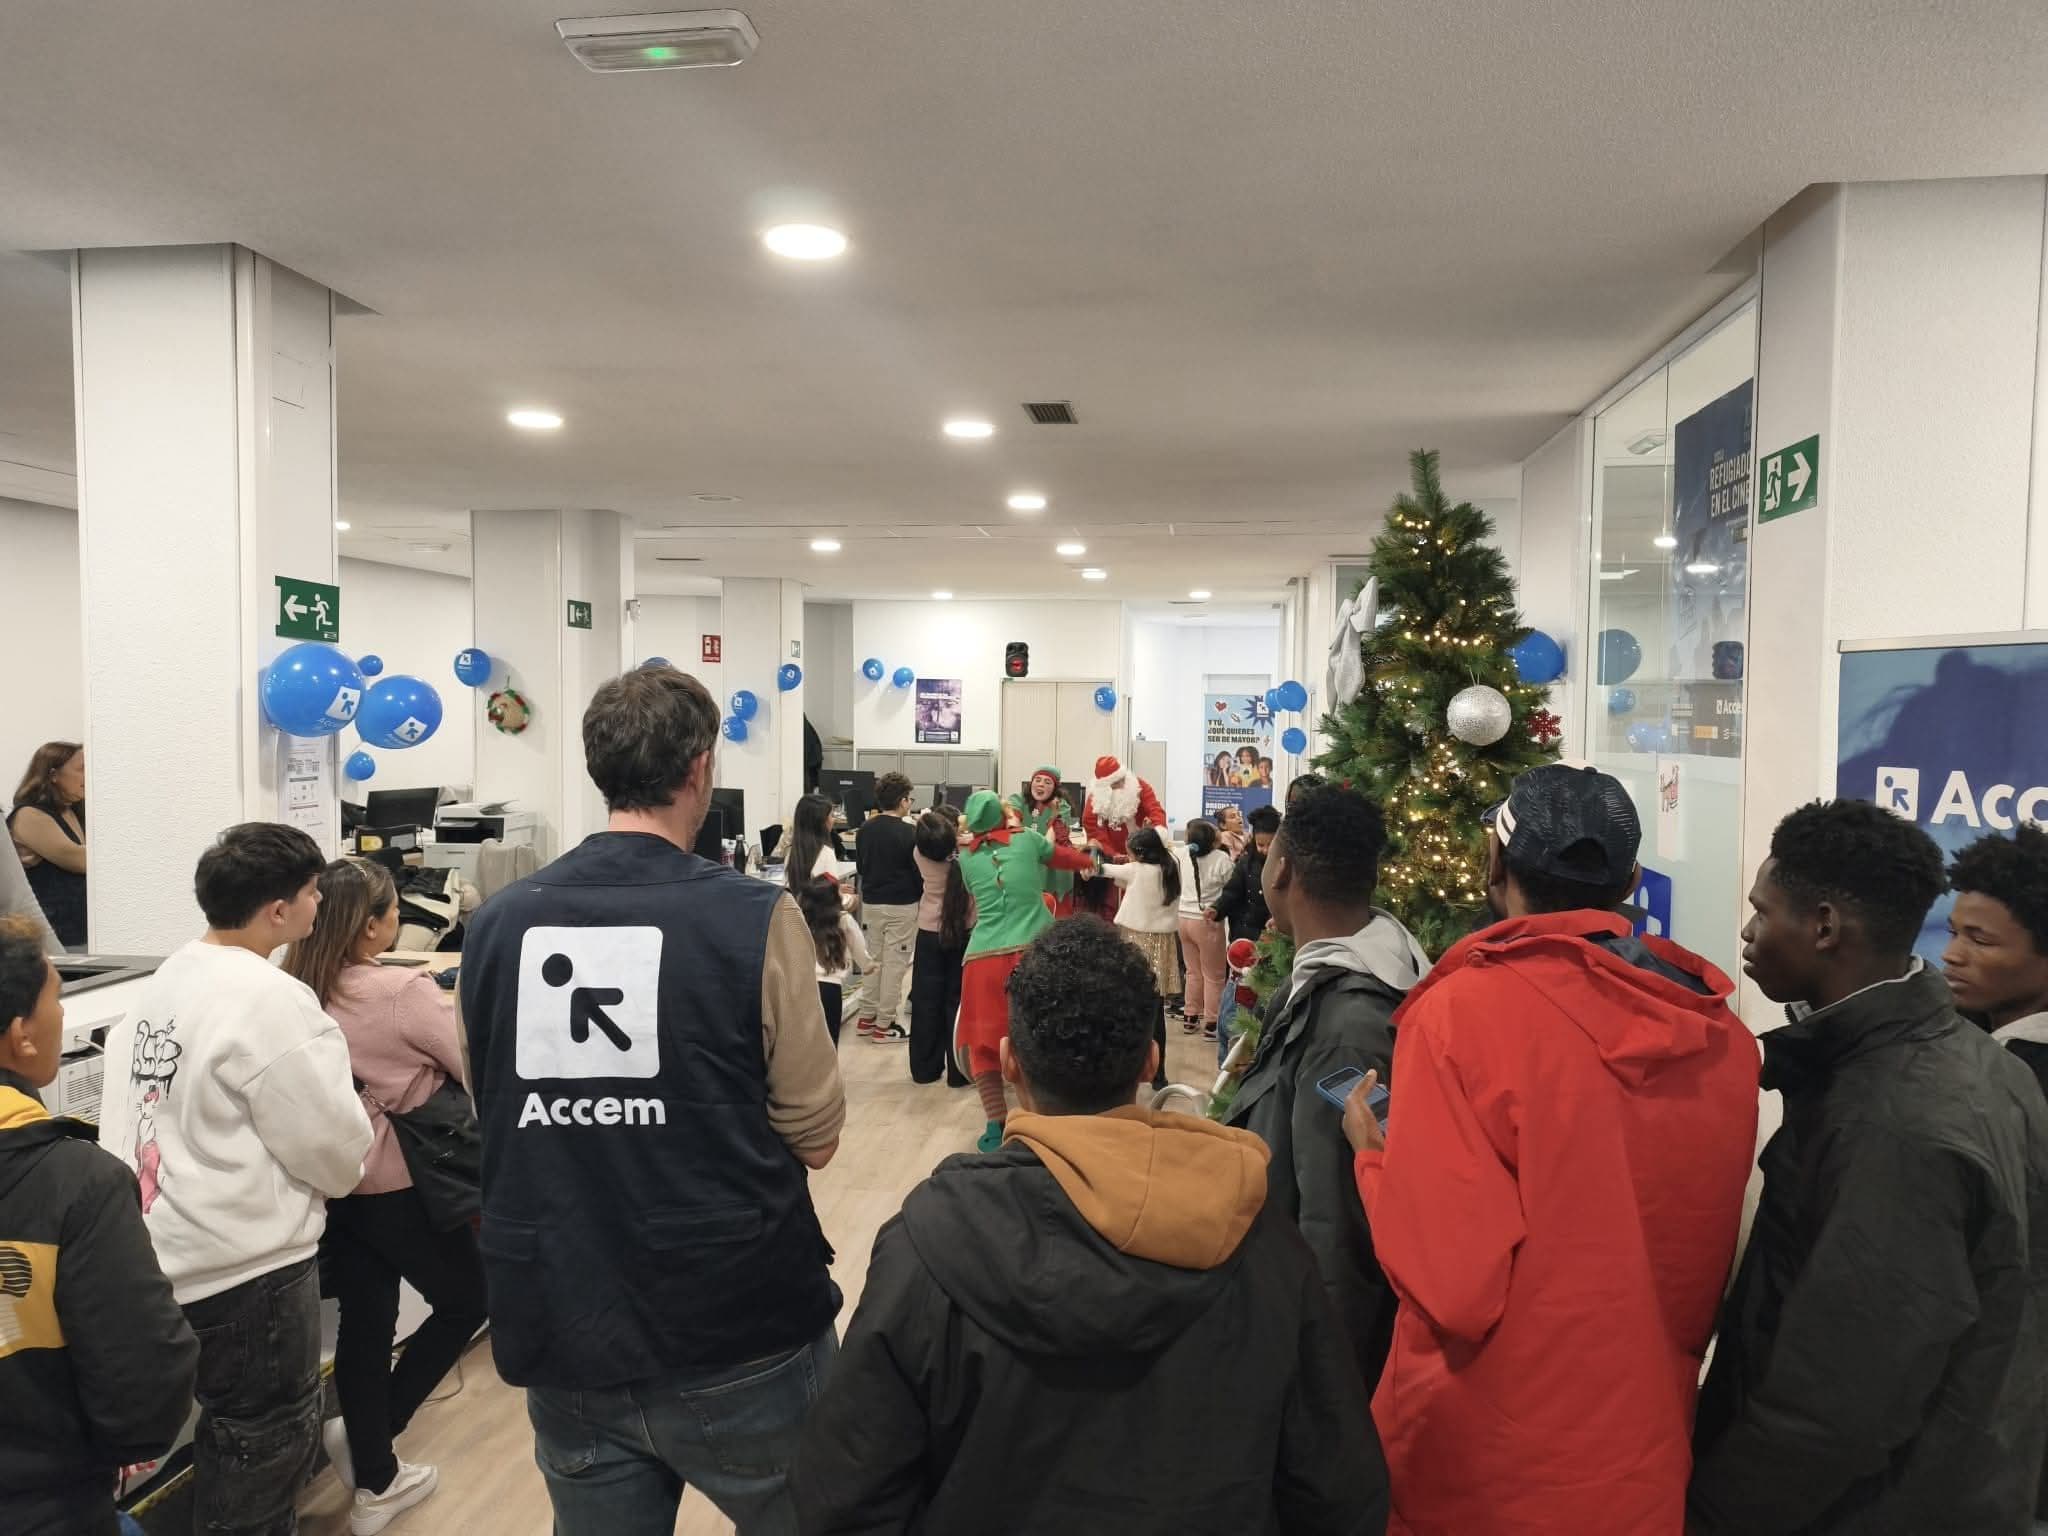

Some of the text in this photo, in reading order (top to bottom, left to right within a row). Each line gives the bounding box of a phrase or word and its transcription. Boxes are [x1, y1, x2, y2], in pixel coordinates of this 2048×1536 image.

[1711, 479, 1750, 518] EN EL CINE
[1207, 735, 1260, 744] SER DE MAYOR?
[1226, 727, 1255, 735] QUIERES
[517, 1091, 667, 1129] Accem
